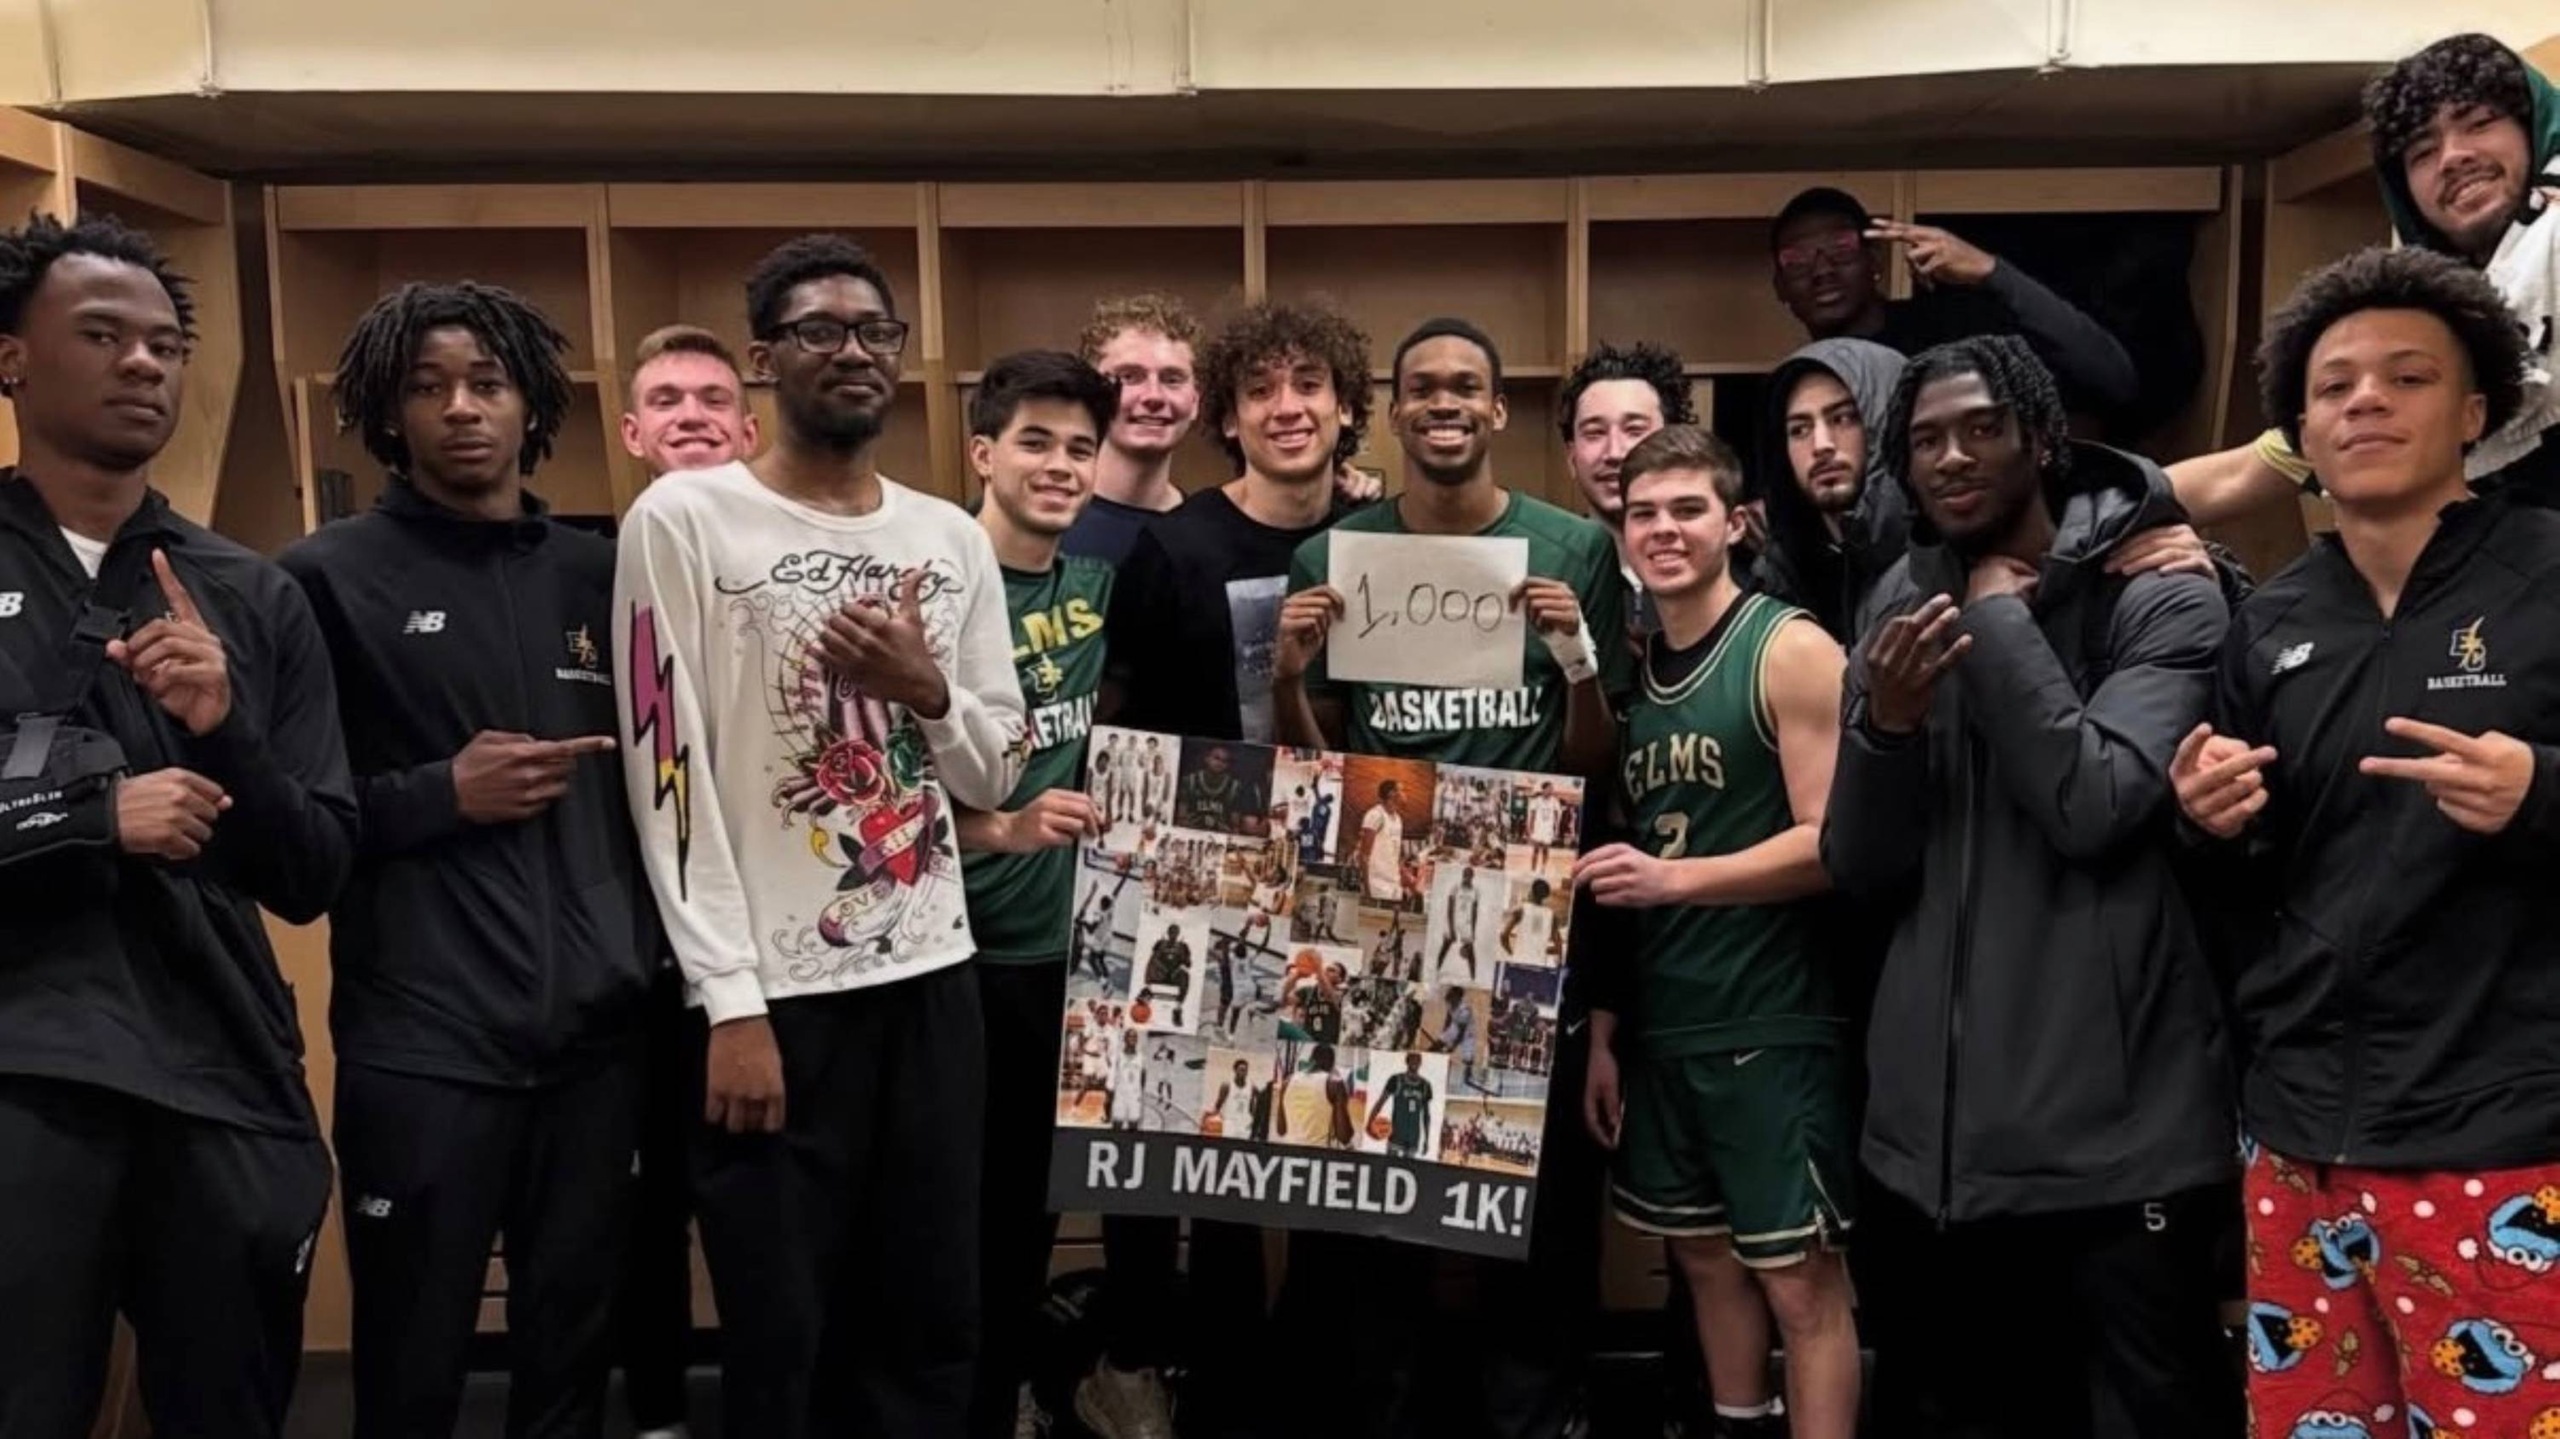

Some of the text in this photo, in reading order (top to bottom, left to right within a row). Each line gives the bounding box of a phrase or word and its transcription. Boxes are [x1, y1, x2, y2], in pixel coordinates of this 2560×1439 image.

[770, 552, 831, 584] Ed
[0, 591, 24, 618] B
[1357, 572, 1504, 639] 1,000
[403, 610, 446, 634] NB
[2427, 673, 2508, 690] BASKETBALL
[1369, 687, 1543, 733] BASKETBALL
[1624, 732, 1725, 801] ELMS
[1087, 1141, 1528, 1238] RJ MAYFIELD 1K!
[2144, 1202, 2166, 1231] 5
